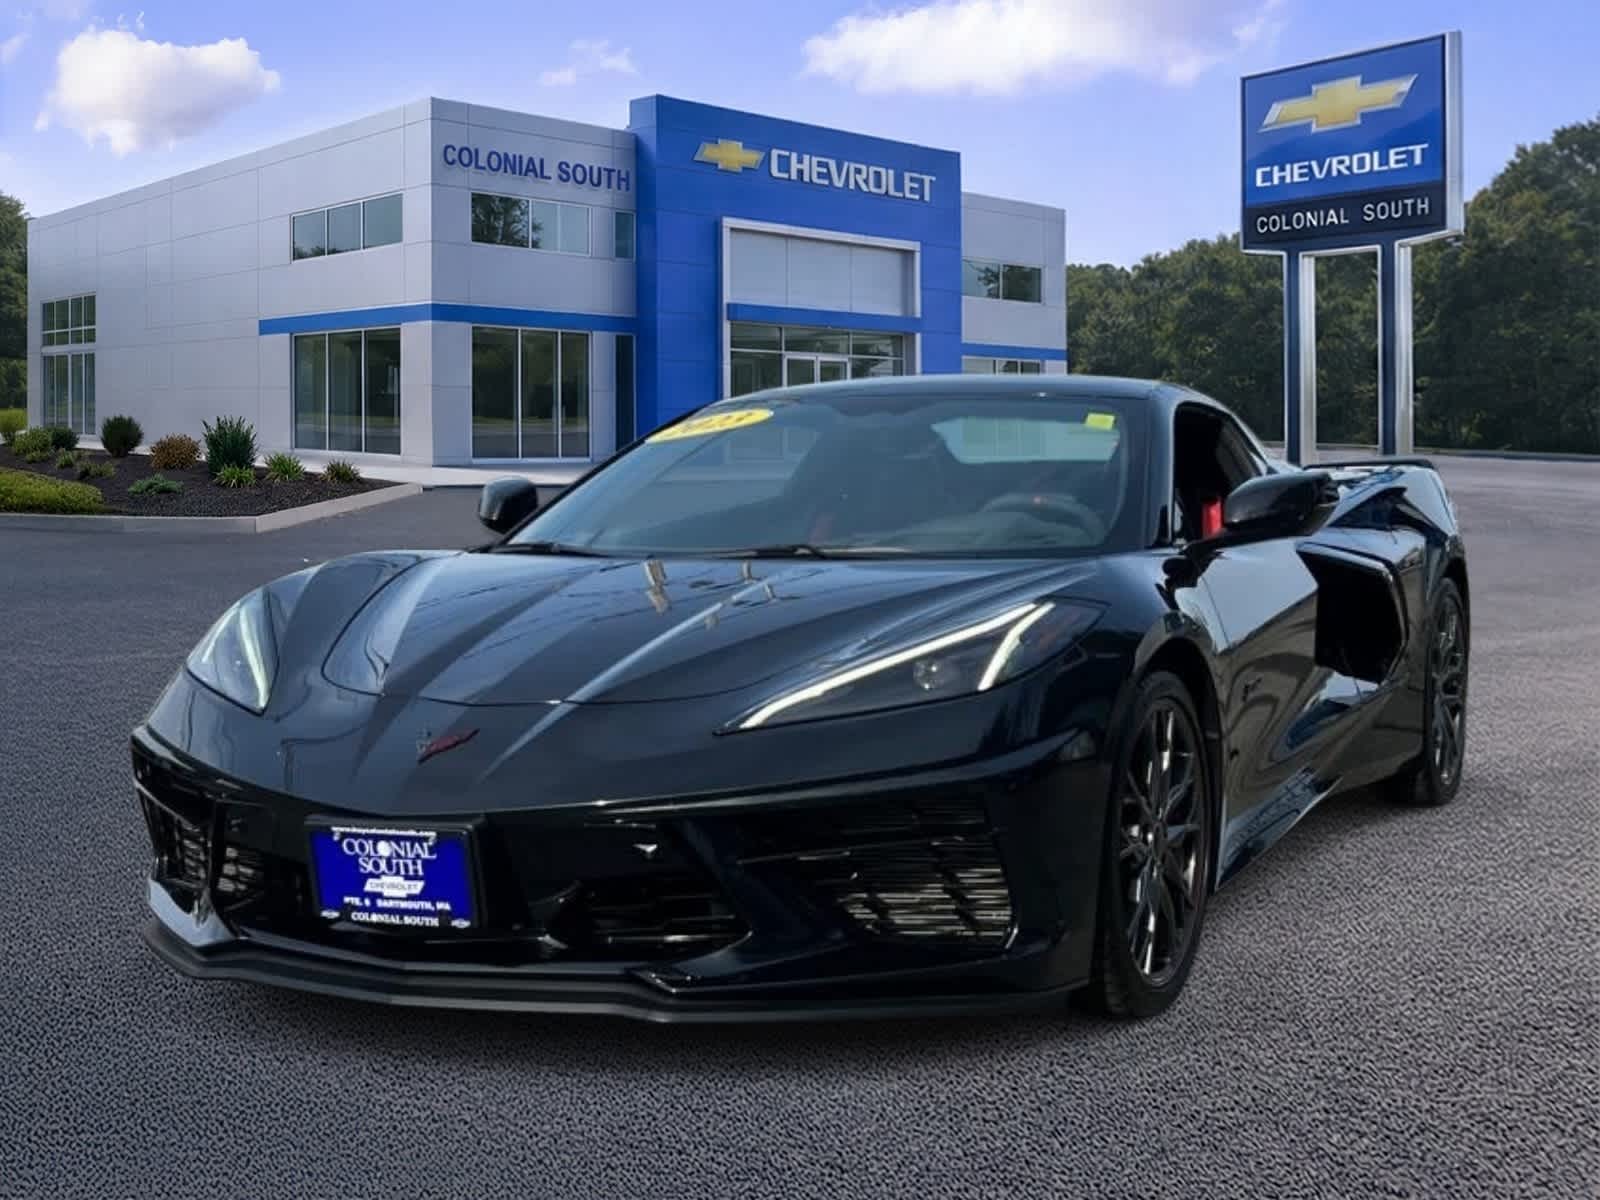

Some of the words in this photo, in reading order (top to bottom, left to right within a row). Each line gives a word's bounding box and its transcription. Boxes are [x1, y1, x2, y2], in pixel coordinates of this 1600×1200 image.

[442, 143, 552, 181] COLONIAL
[558, 160, 630, 192] SOUTH
[769, 148, 936, 202] CHEVROLET
[1255, 143, 1429, 187] CHEVROLET
[1256, 208, 1349, 234] COLONIAL
[1362, 197, 1429, 222] SOUTH
[342, 838, 437, 859] COLONIAL
[358, 856, 424, 876] SOUTH
[368, 880, 419, 891] CHEVROLET
[351, 911, 403, 925] COLONIAL
[404, 913, 440, 927] SOUTH
